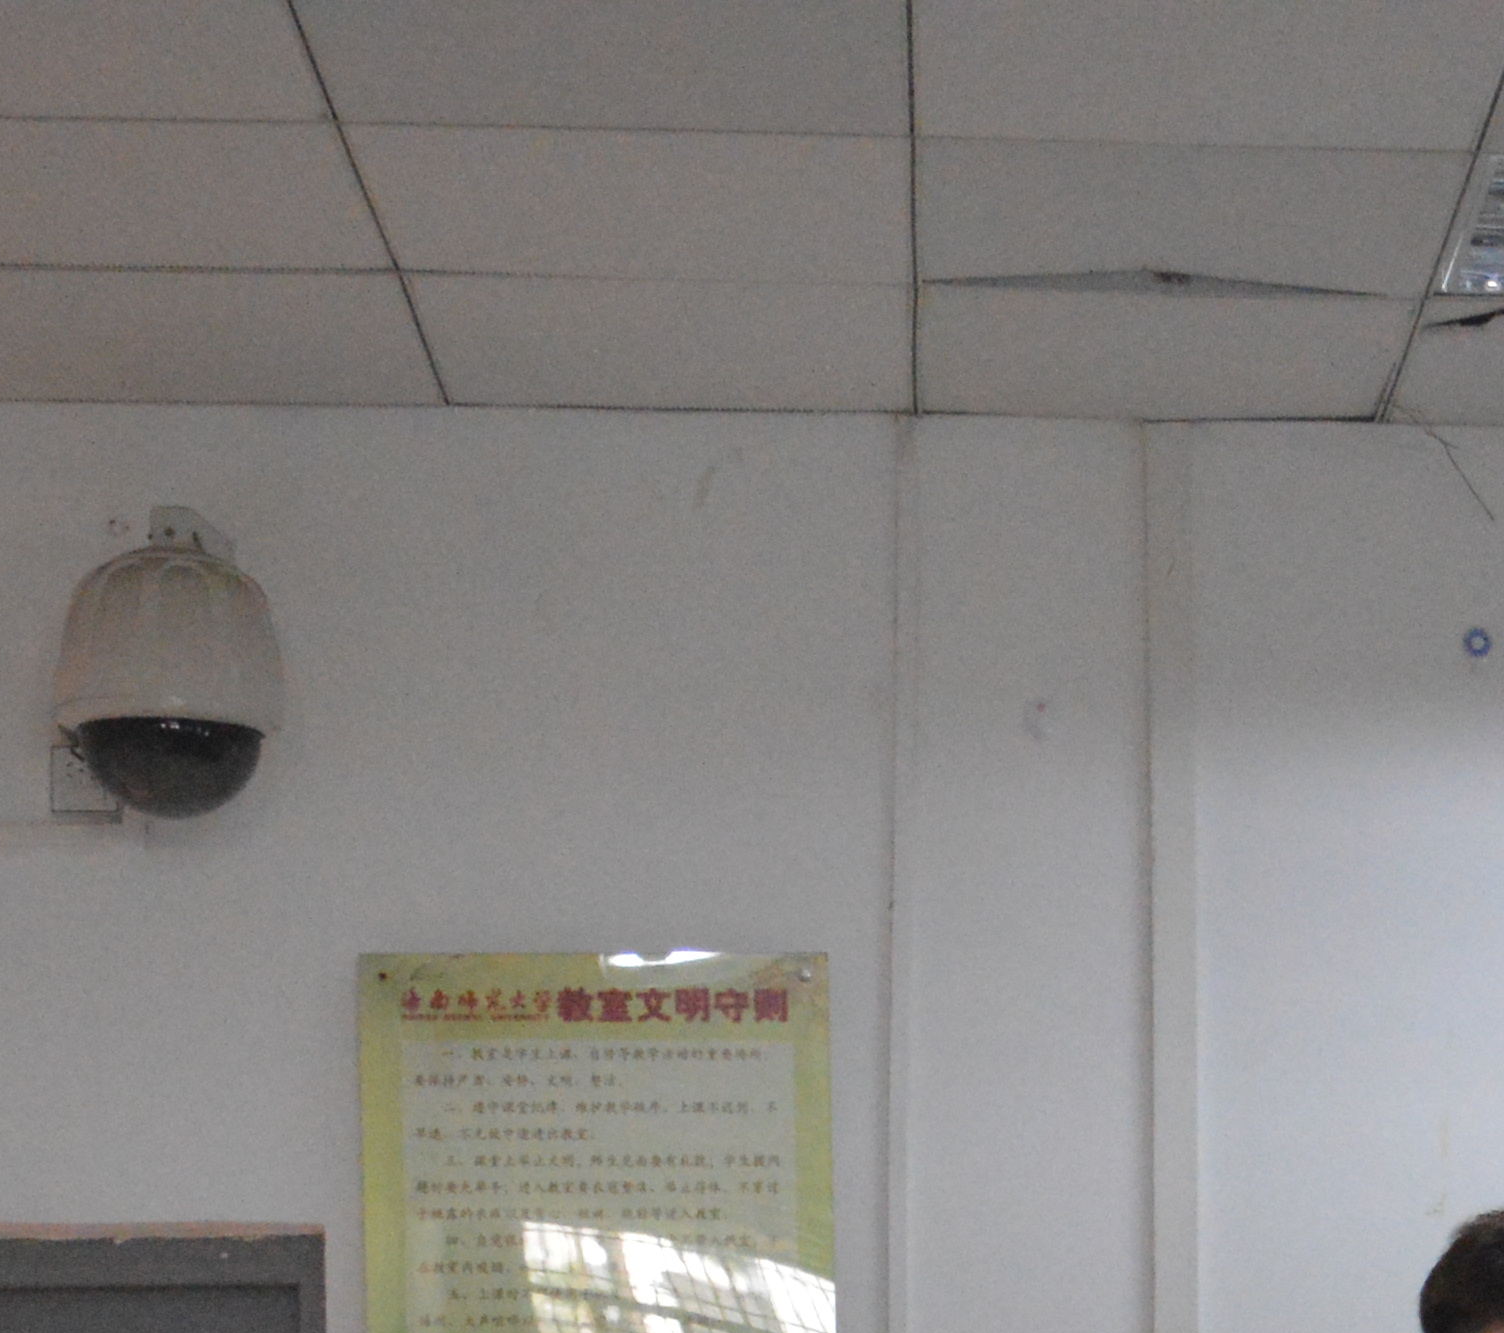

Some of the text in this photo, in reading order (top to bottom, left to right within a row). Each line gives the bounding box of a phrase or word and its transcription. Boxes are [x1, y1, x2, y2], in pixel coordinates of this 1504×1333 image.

[557, 987, 789, 1022] 教室文明守则
